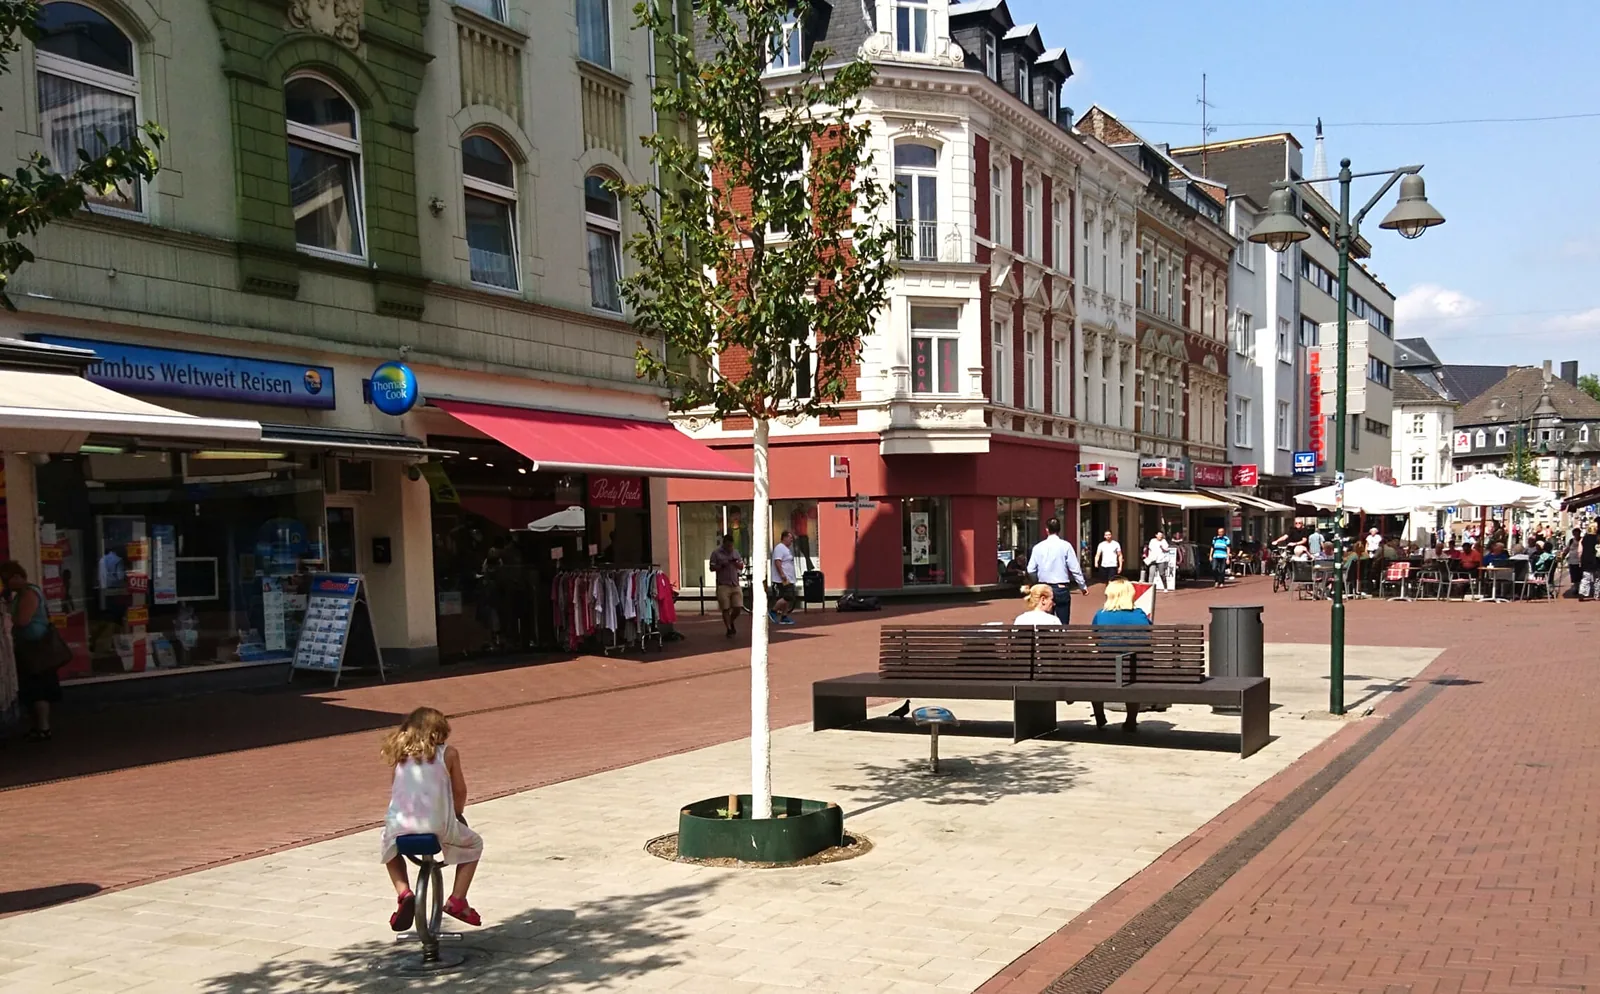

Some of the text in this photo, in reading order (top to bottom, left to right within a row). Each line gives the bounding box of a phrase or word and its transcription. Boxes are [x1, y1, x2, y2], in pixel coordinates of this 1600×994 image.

[917, 341, 926, 391] YOGA
[160, 363, 236, 389] Weltweit
[241, 370, 293, 394] Reisen
[373, 380, 407, 391] Thomas
[385, 389, 407, 400] Cook
[592, 478, 618, 502] Body
